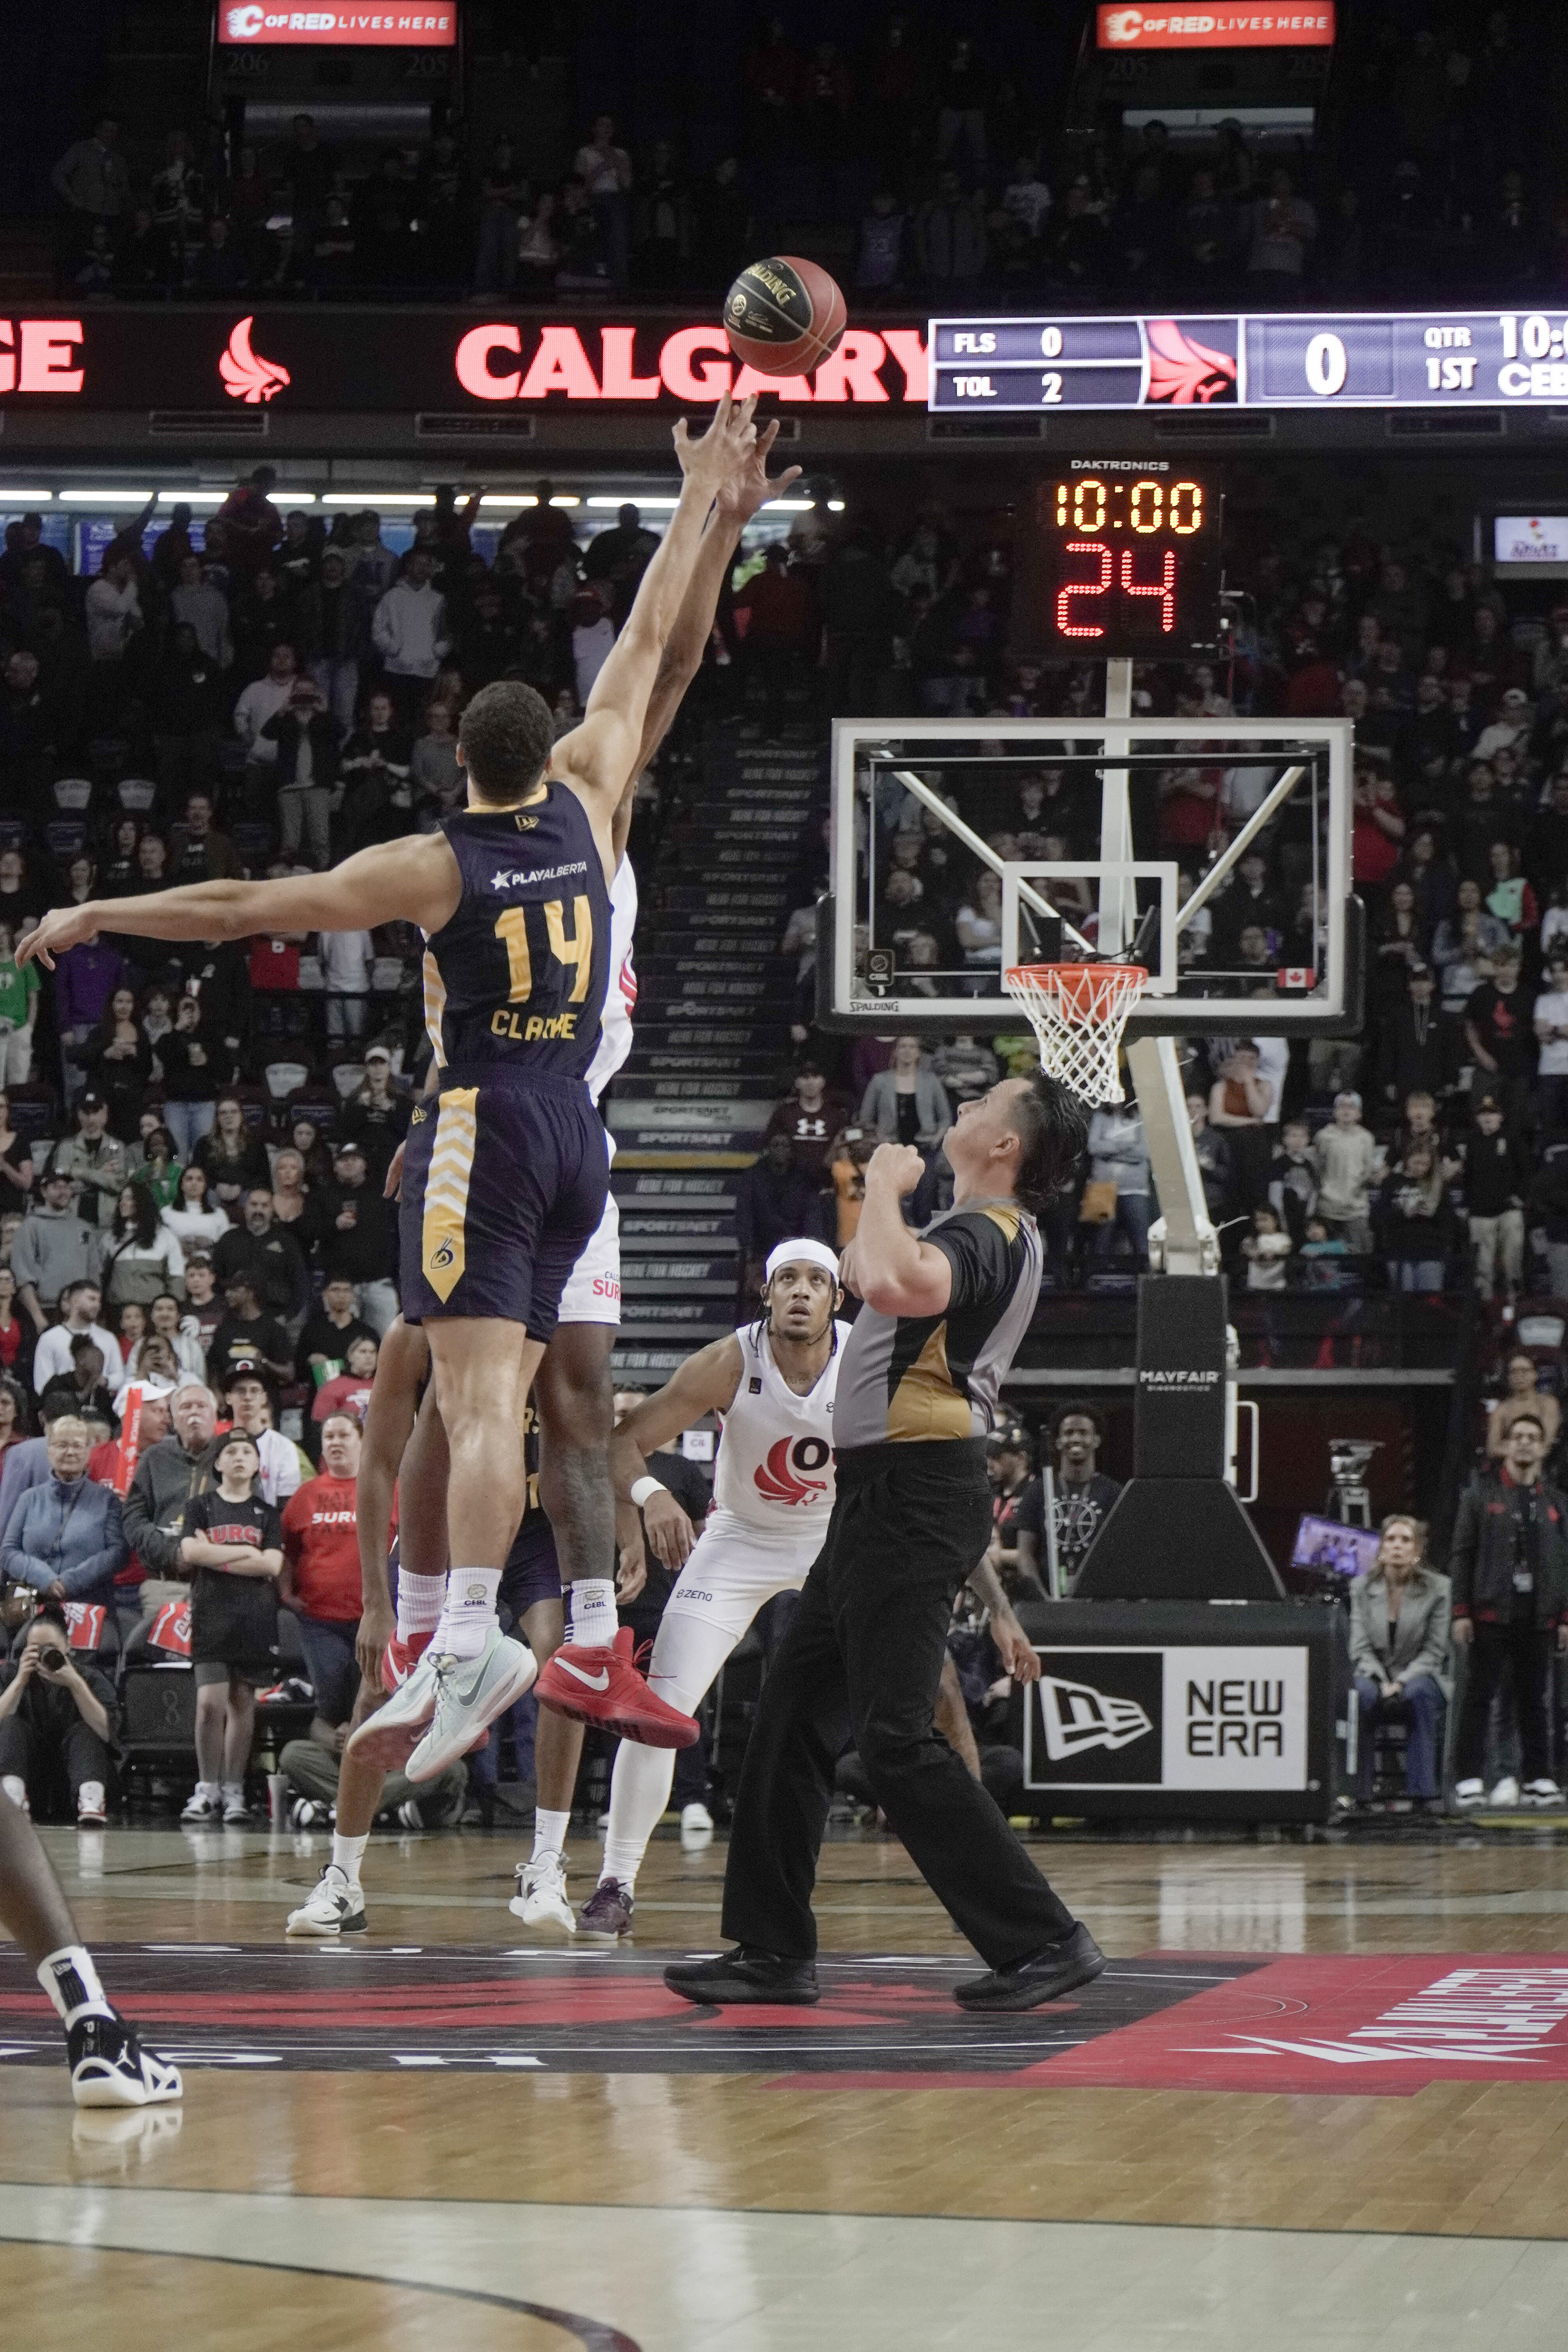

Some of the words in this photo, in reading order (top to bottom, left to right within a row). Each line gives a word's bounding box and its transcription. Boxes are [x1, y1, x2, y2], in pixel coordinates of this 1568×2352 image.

[265, 15, 288, 27] OF
[288, 13, 336, 30] RED
[338, 16, 394, 29] LIVES
[398, 17, 450, 30] HERE
[1143, 19, 1168, 31] OF
[1168, 16, 1215, 33] RED
[1216, 17, 1273, 29] LIVES
[1276, 17, 1329, 29] HERE
[954, 333, 996, 352] FLS
[1041, 327, 1062, 357] 0
[1425, 327, 1471, 349] QTR
[1499, 316, 1568, 358] 10:
[0, 320, 85, 392] E
[1306, 333, 1347, 395] 0
[953, 377, 998, 396] TOL
[1042, 372, 1062, 403] 2
[1426, 358, 1478, 389] 1ST
[1071, 460, 1169, 471] DAKTRONICS
[1058, 481, 1202, 534] 10:00
[1057, 543, 1175, 636] 24
[512, 861, 587, 885] PLAYALBERTA
[494, 895, 593, 1003] 14
[850, 1001, 899, 1012] SPALDING
[593, 1279, 621, 1301] SUR
[1140, 1370, 1218, 1383] MAYFAIR
[792, 1437, 836, 1471] 0
[584, 1601, 606, 1609] CEBL
[1187, 1679, 1284, 1716] NEW
[1187, 1720, 1283, 1757] ERA
